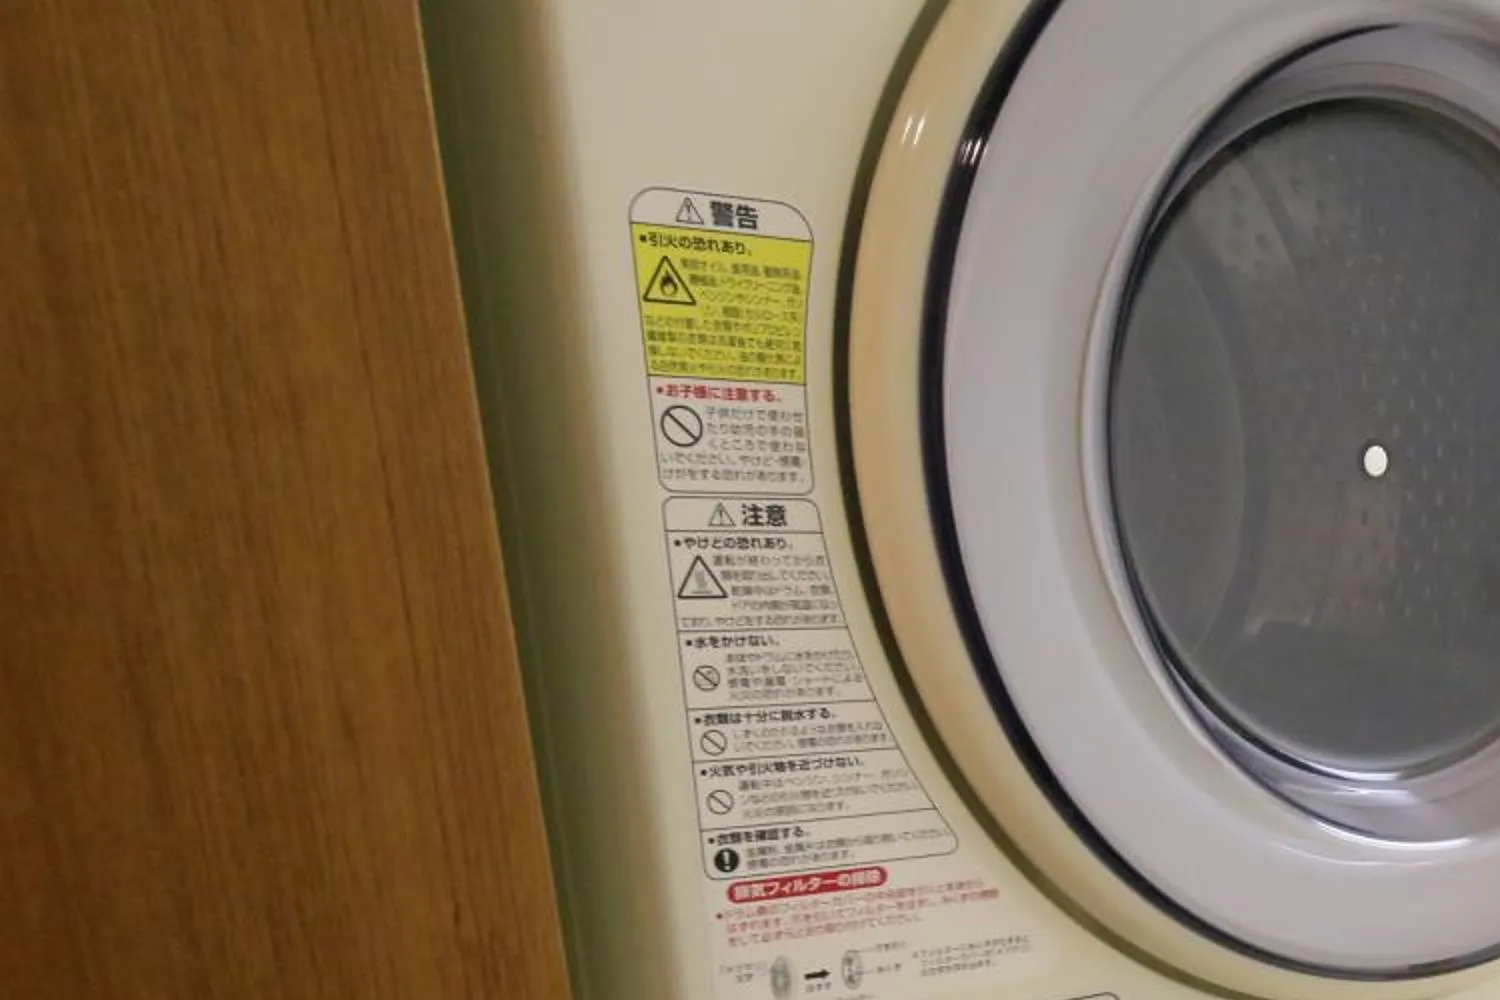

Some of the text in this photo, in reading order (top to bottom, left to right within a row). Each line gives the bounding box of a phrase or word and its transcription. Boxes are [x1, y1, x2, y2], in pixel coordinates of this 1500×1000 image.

[710, 201, 758, 229] 警告
[648, 231, 752, 256] 引火の恐れあり。
[666, 384, 781, 402] お子様に注意する。
[742, 504, 788, 527] 注意
